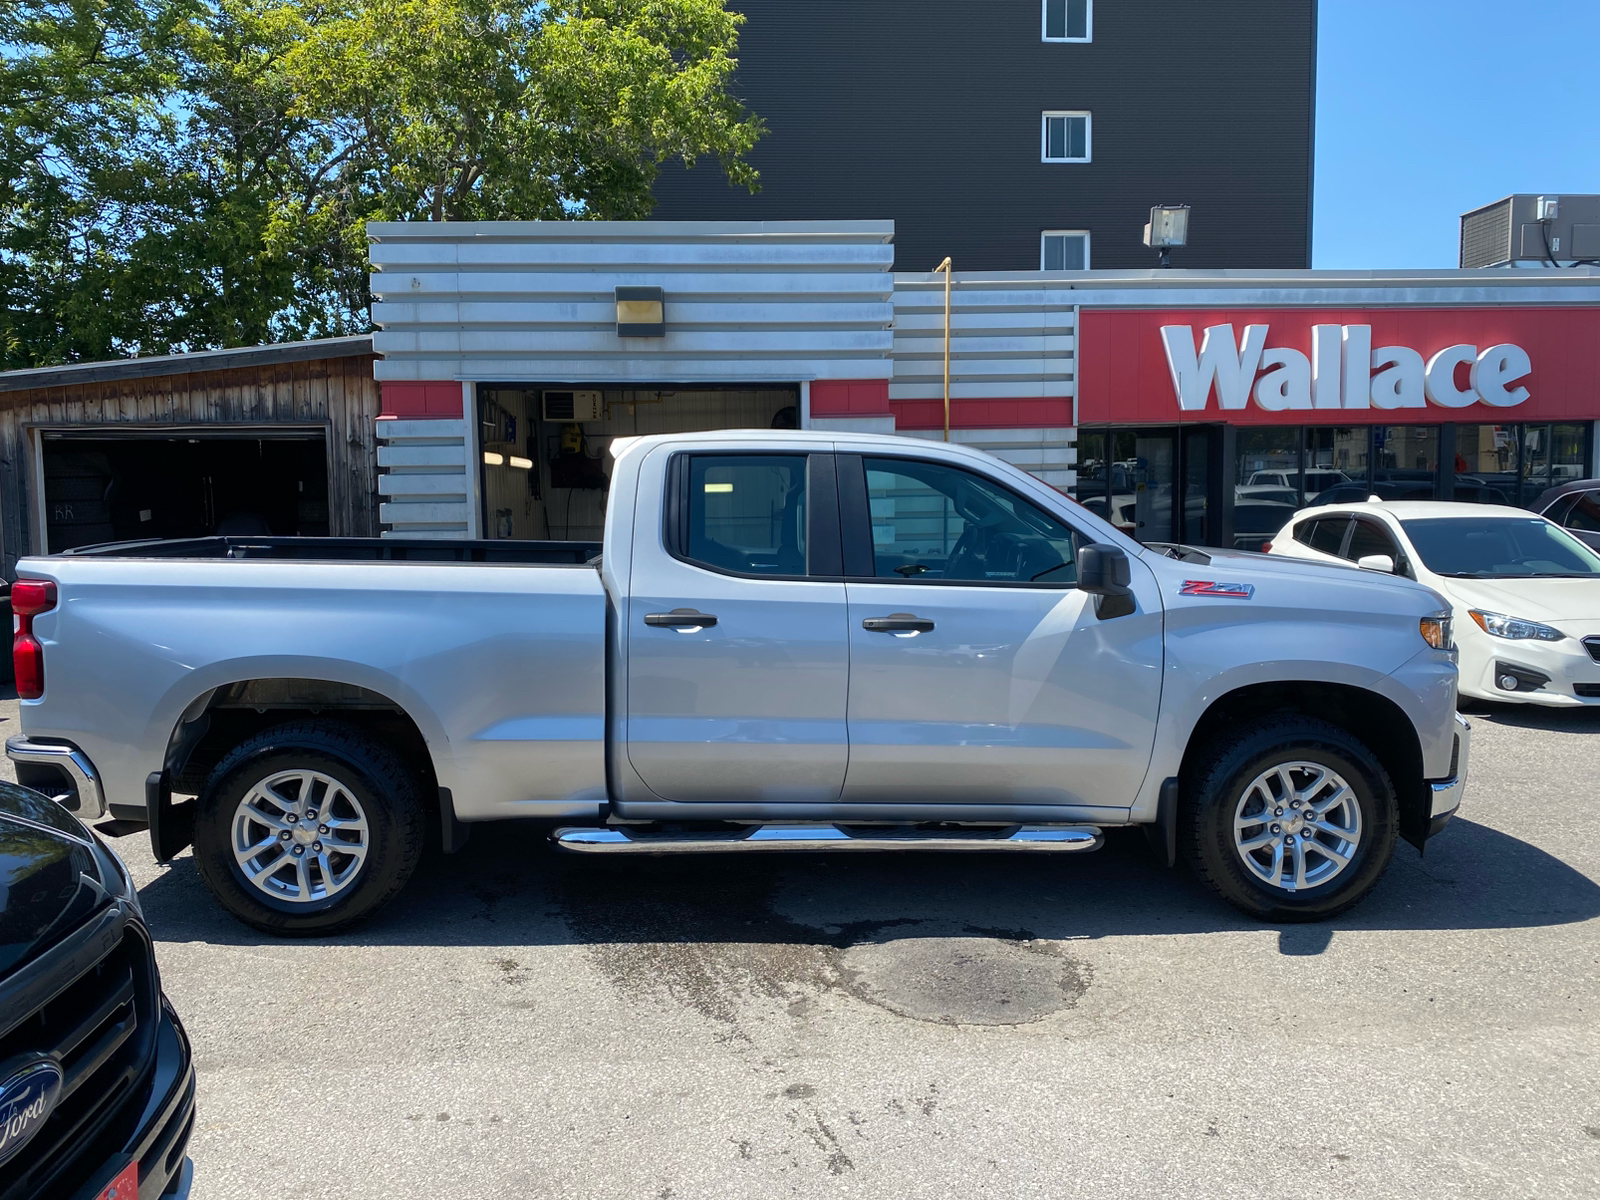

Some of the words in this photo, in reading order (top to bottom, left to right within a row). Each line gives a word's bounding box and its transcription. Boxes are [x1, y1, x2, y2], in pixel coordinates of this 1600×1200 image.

[1160, 323, 1532, 411] Wallace
[1180, 580, 1255, 600] Z71
[0, 1083, 47, 1150] Ford
